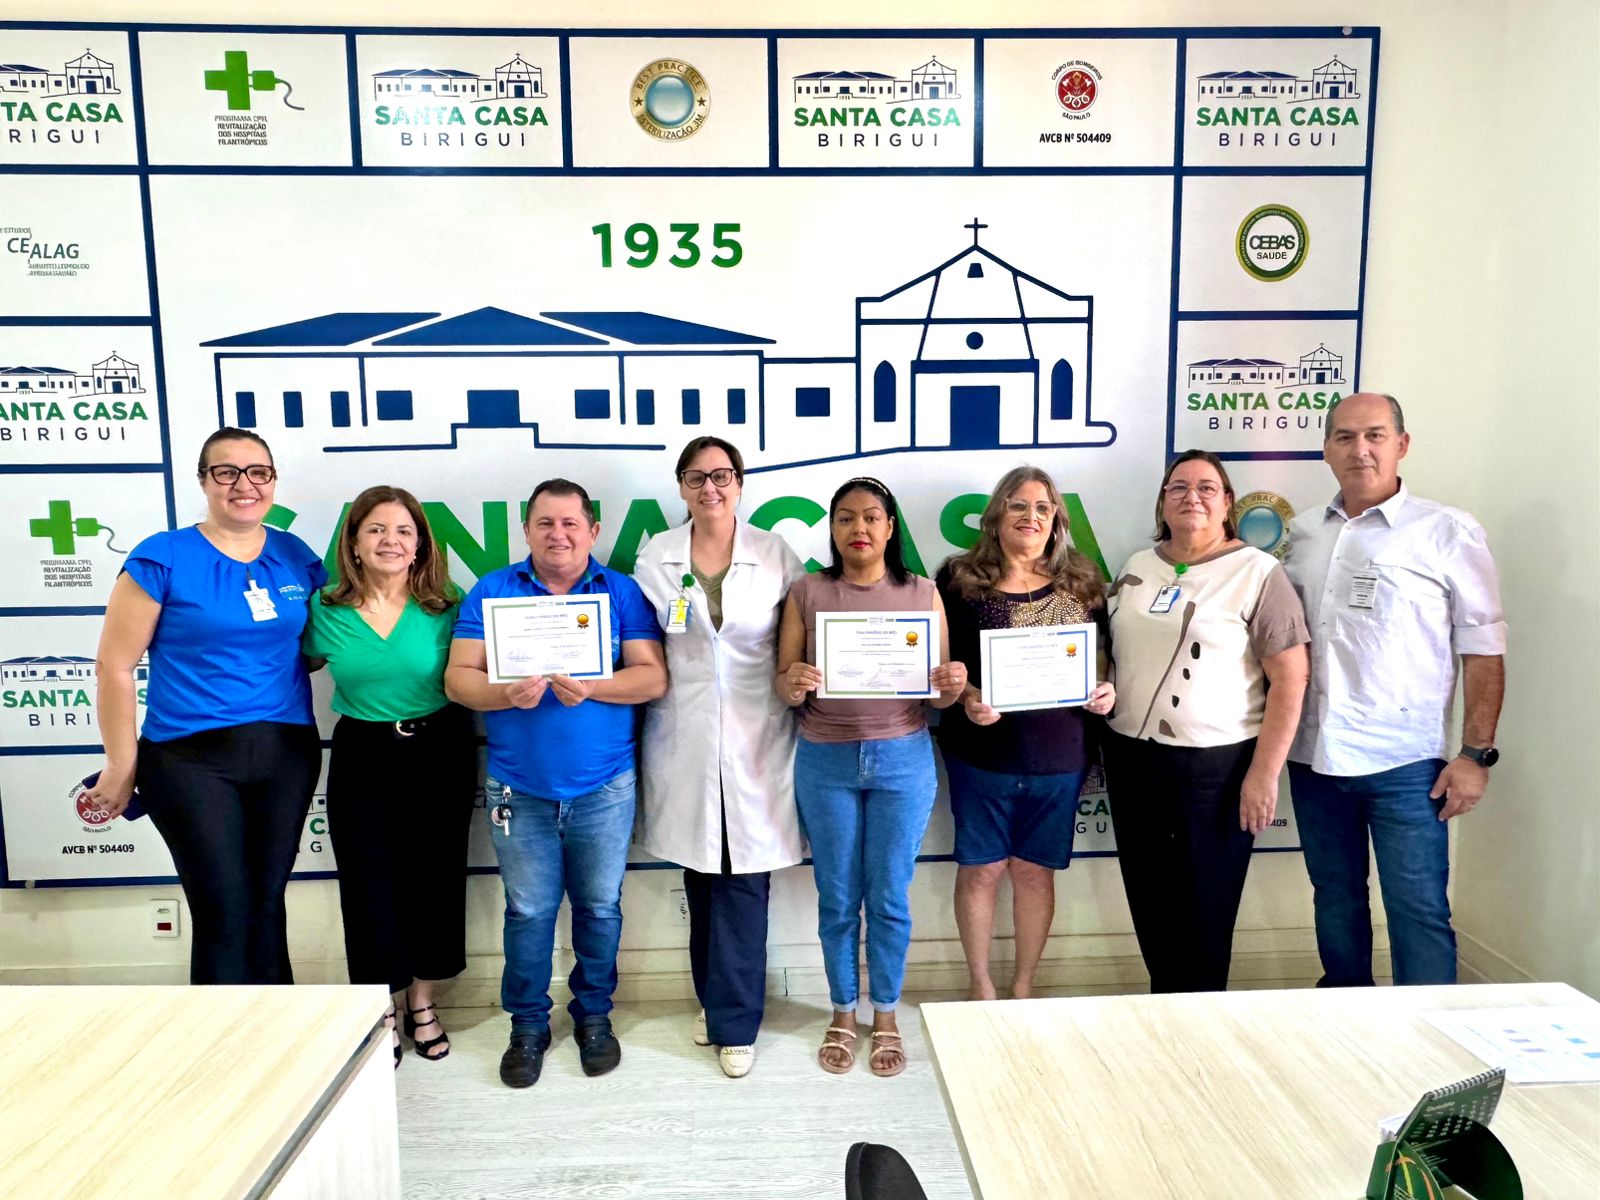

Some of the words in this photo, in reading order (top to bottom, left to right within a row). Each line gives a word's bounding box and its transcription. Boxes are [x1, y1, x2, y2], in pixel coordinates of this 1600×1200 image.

[636, 67, 653, 90] BEST
[657, 62, 702, 88] PRACTICE
[1051, 64, 1066, 81] CORPO
[46, 101, 123, 123] CASA
[375, 106, 466, 126] SANTA
[475, 106, 549, 126] CASA
[794, 107, 882, 127] SANTA
[890, 107, 961, 127] CASA
[1196, 107, 1281, 127] SANTA
[1290, 107, 1359, 126] CASA
[217, 122, 266, 131] REVITALIZAÇÃO
[693, 113, 704, 129] 3M
[218, 138, 268, 146] FILANTRÓPICOS
[401, 132, 525, 147] BIRIGUI
[818, 133, 937, 148] BIRIGUI
[1039, 133, 1062, 143] AVCB
[1076, 133, 1112, 143] 504409
[1218, 132, 1336, 147] BIRIGUI
[592, 222, 743, 268] 1935
[1249, 235, 1295, 250] CEBAS
[1187, 392, 1269, 411] SANTA
[73, 401, 148, 421] CASA
[1208, 416, 1322, 430] BIRIGUI
[0, 427, 125, 441] BIRIGUI
[3, 689, 92, 708] SANTA
[28, 713, 91, 727] BIRI
[62, 845, 85, 855] AVCB
[99, 844, 135, 853] 504409
